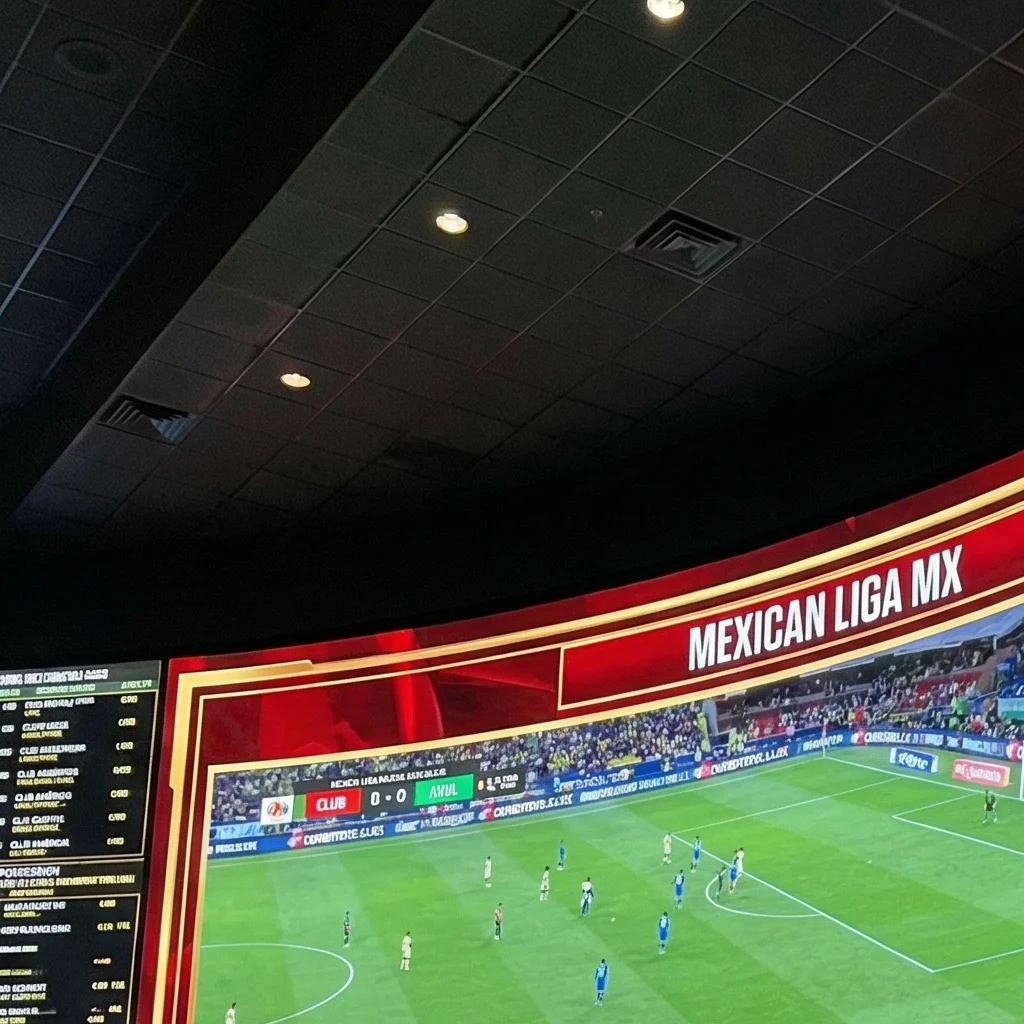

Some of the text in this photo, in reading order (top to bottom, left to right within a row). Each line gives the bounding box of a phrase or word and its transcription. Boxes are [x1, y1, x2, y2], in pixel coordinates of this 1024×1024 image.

[688, 544, 963, 671] MEXICAN LIGA MX
